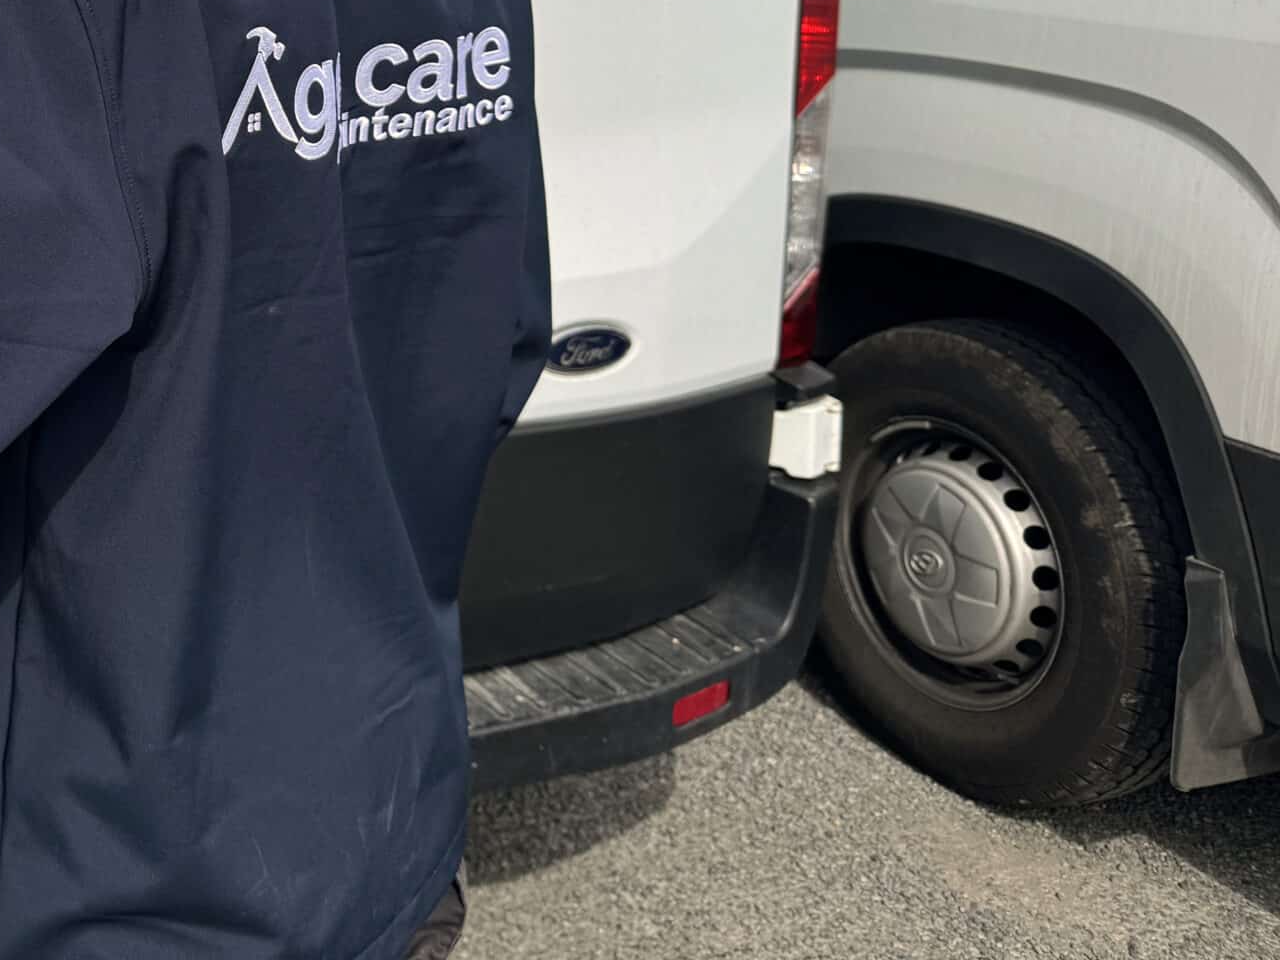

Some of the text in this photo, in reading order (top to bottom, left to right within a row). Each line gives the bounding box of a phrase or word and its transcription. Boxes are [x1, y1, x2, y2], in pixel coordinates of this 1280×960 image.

[355, 26, 511, 107] care
[340, 94, 514, 149] intenance
[559, 336, 616, 366] Ford
